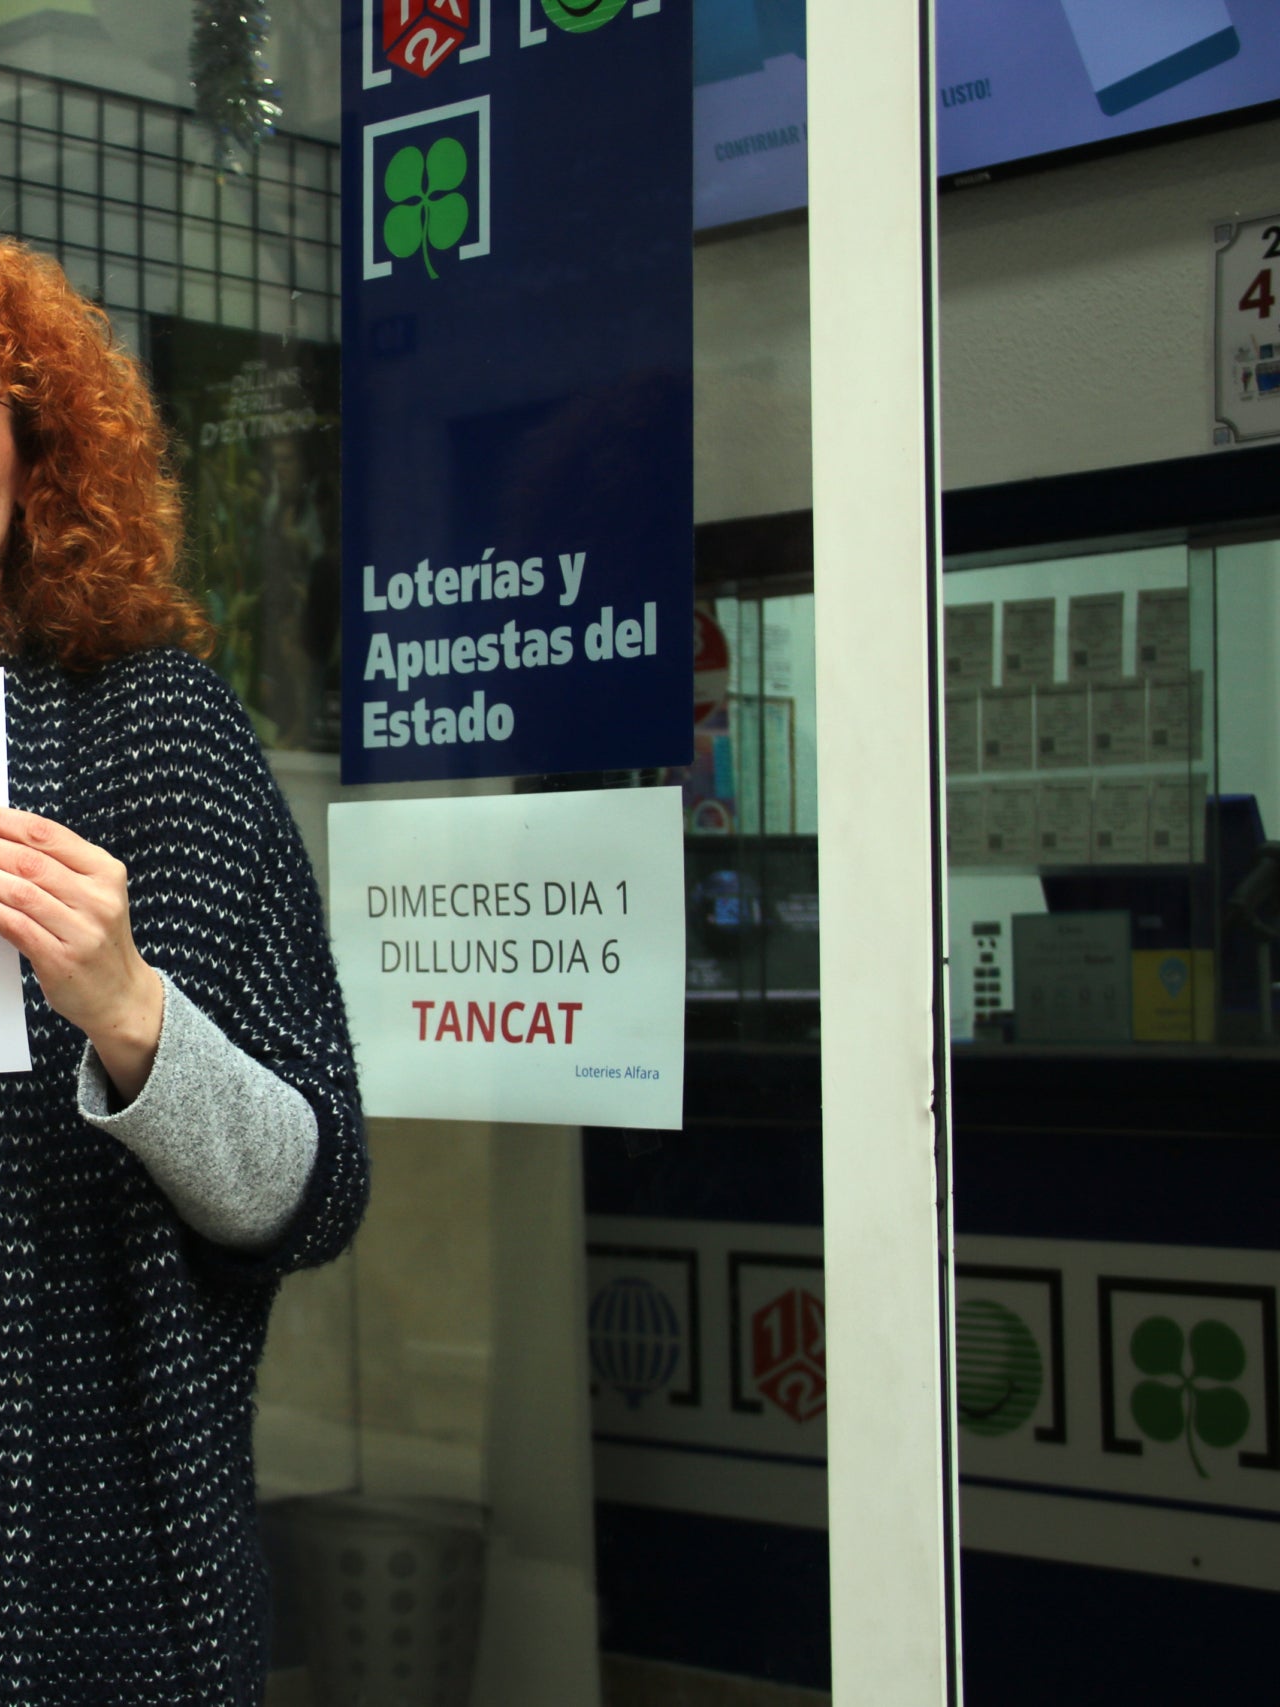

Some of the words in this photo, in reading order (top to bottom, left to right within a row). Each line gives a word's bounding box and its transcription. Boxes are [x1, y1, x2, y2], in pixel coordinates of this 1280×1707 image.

[940, 78, 993, 109] LISTO!
[714, 124, 800, 163] CONFIRMAR
[362, 547, 545, 613] Loterías
[558, 551, 587, 607] y
[362, 617, 575, 692] Apuestas
[584, 601, 658, 663] del
[362, 690, 515, 749] Estado
[366, 882, 532, 919] DIMECRES
[543, 880, 604, 917] DIA
[615, 879, 629, 916] 1
[380, 939, 519, 974] DILLUNS
[531, 938, 590, 974] DIA
[601, 938, 621, 975] 6
[412, 999, 583, 1045] TANCAT
[575, 1064, 622, 1079] Loteries
[623, 1065, 660, 1080] Alfara
